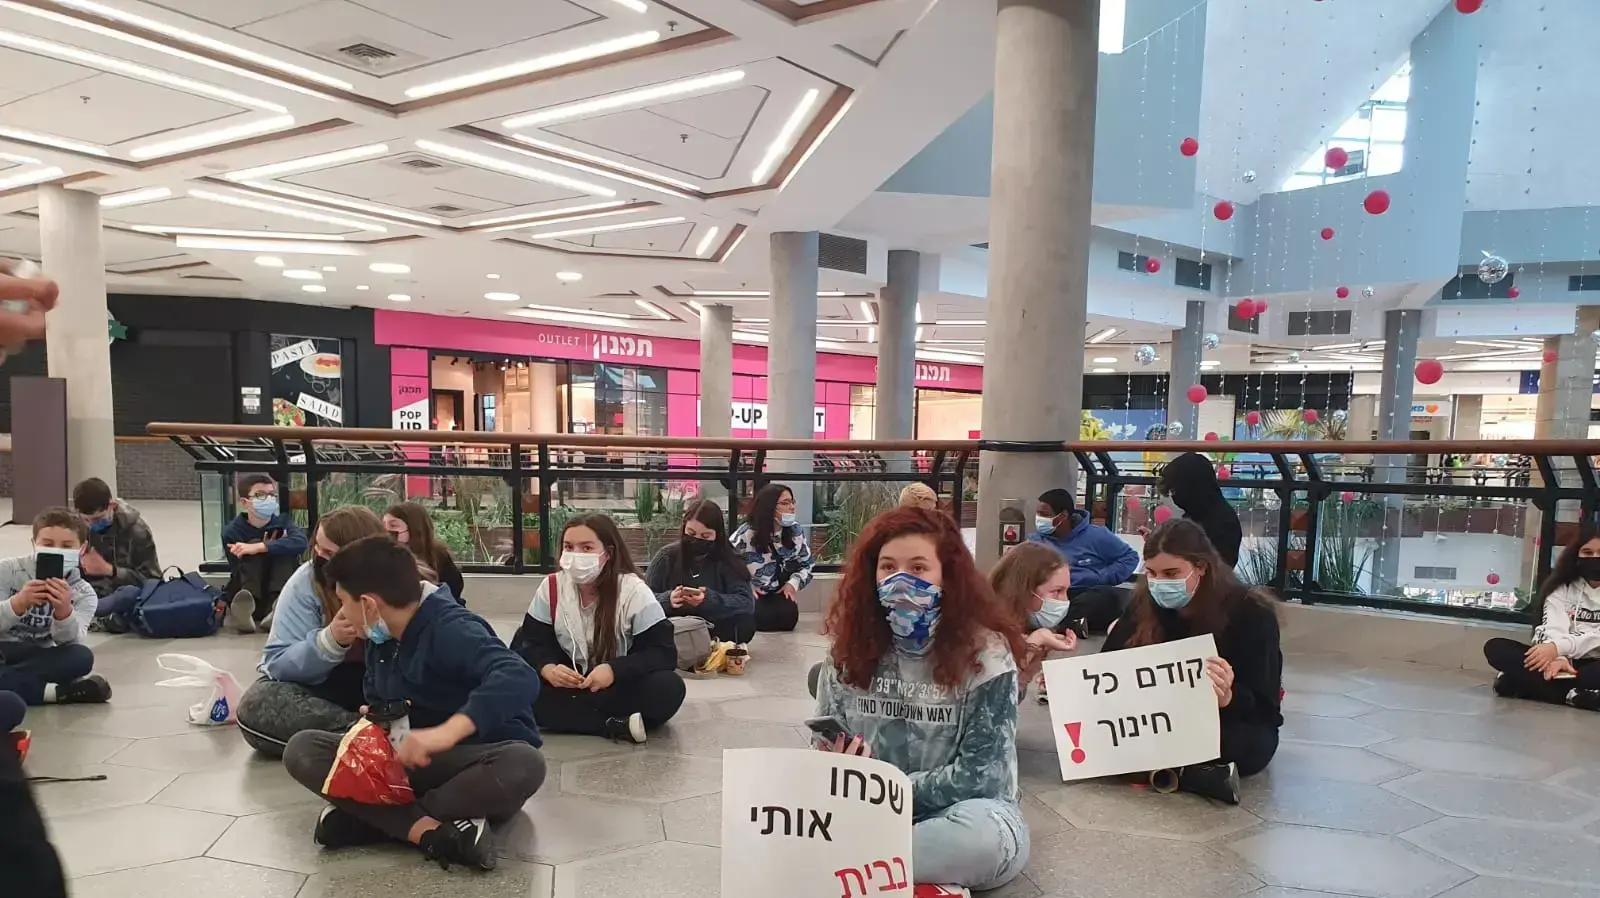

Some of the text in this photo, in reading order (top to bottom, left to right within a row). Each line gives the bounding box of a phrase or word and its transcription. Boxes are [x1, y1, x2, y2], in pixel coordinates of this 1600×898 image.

[538, 333, 580, 346] OUTLET
[592, 333, 653, 359] תמנון
[915, 364, 950, 382] תמנו
[400, 410, 422, 420] POP
[1082, 657, 1203, 695] קודם כל
[926, 706, 953, 723] WAY
[1097, 711, 1172, 747] חינוך
[829, 766, 904, 816] שכחו
[750, 806, 833, 842] אותי
